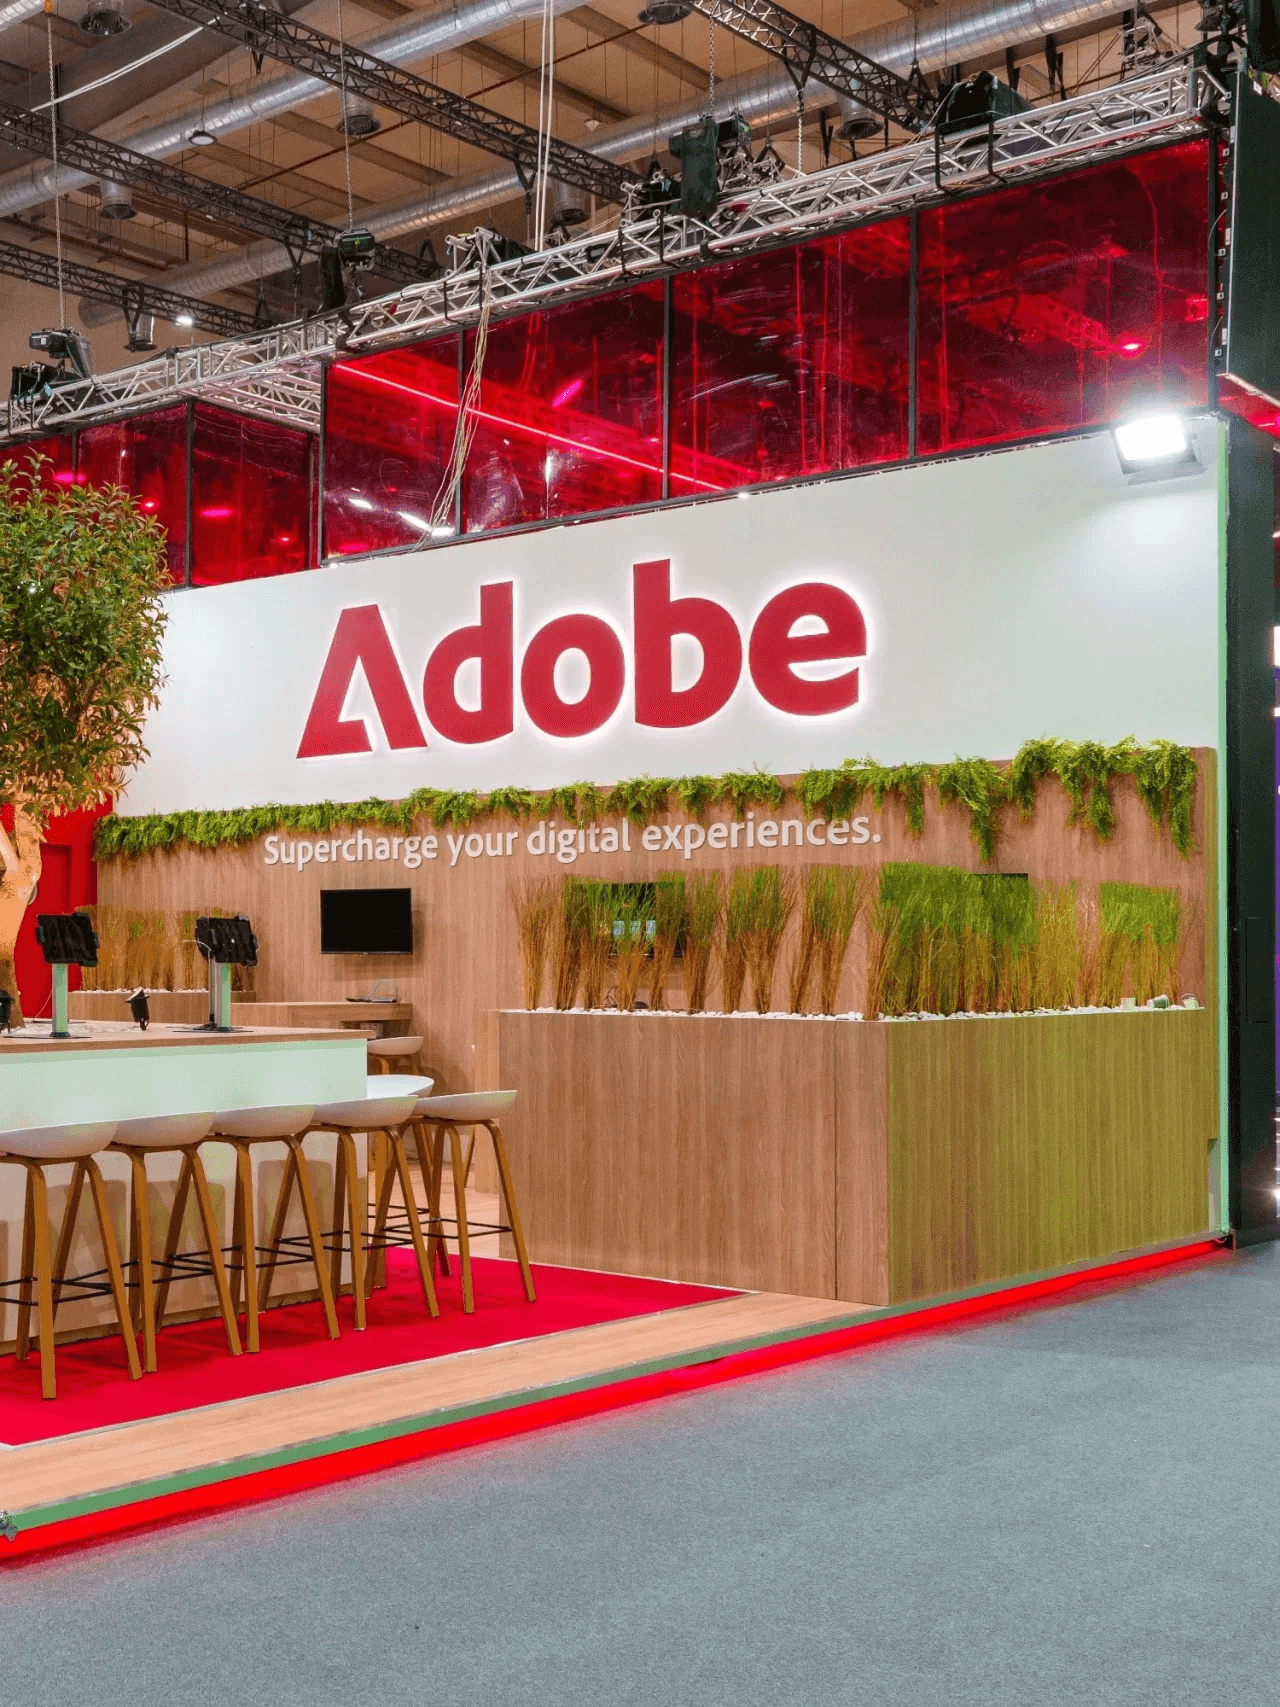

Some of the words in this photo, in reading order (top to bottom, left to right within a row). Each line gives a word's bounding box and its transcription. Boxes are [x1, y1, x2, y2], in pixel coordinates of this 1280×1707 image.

[296, 558, 867, 759] Adobe
[262, 829, 441, 873] Supercharge
[446, 830, 519, 868] your
[526, 817, 632, 866] digital
[641, 811, 884, 862] experiences.
